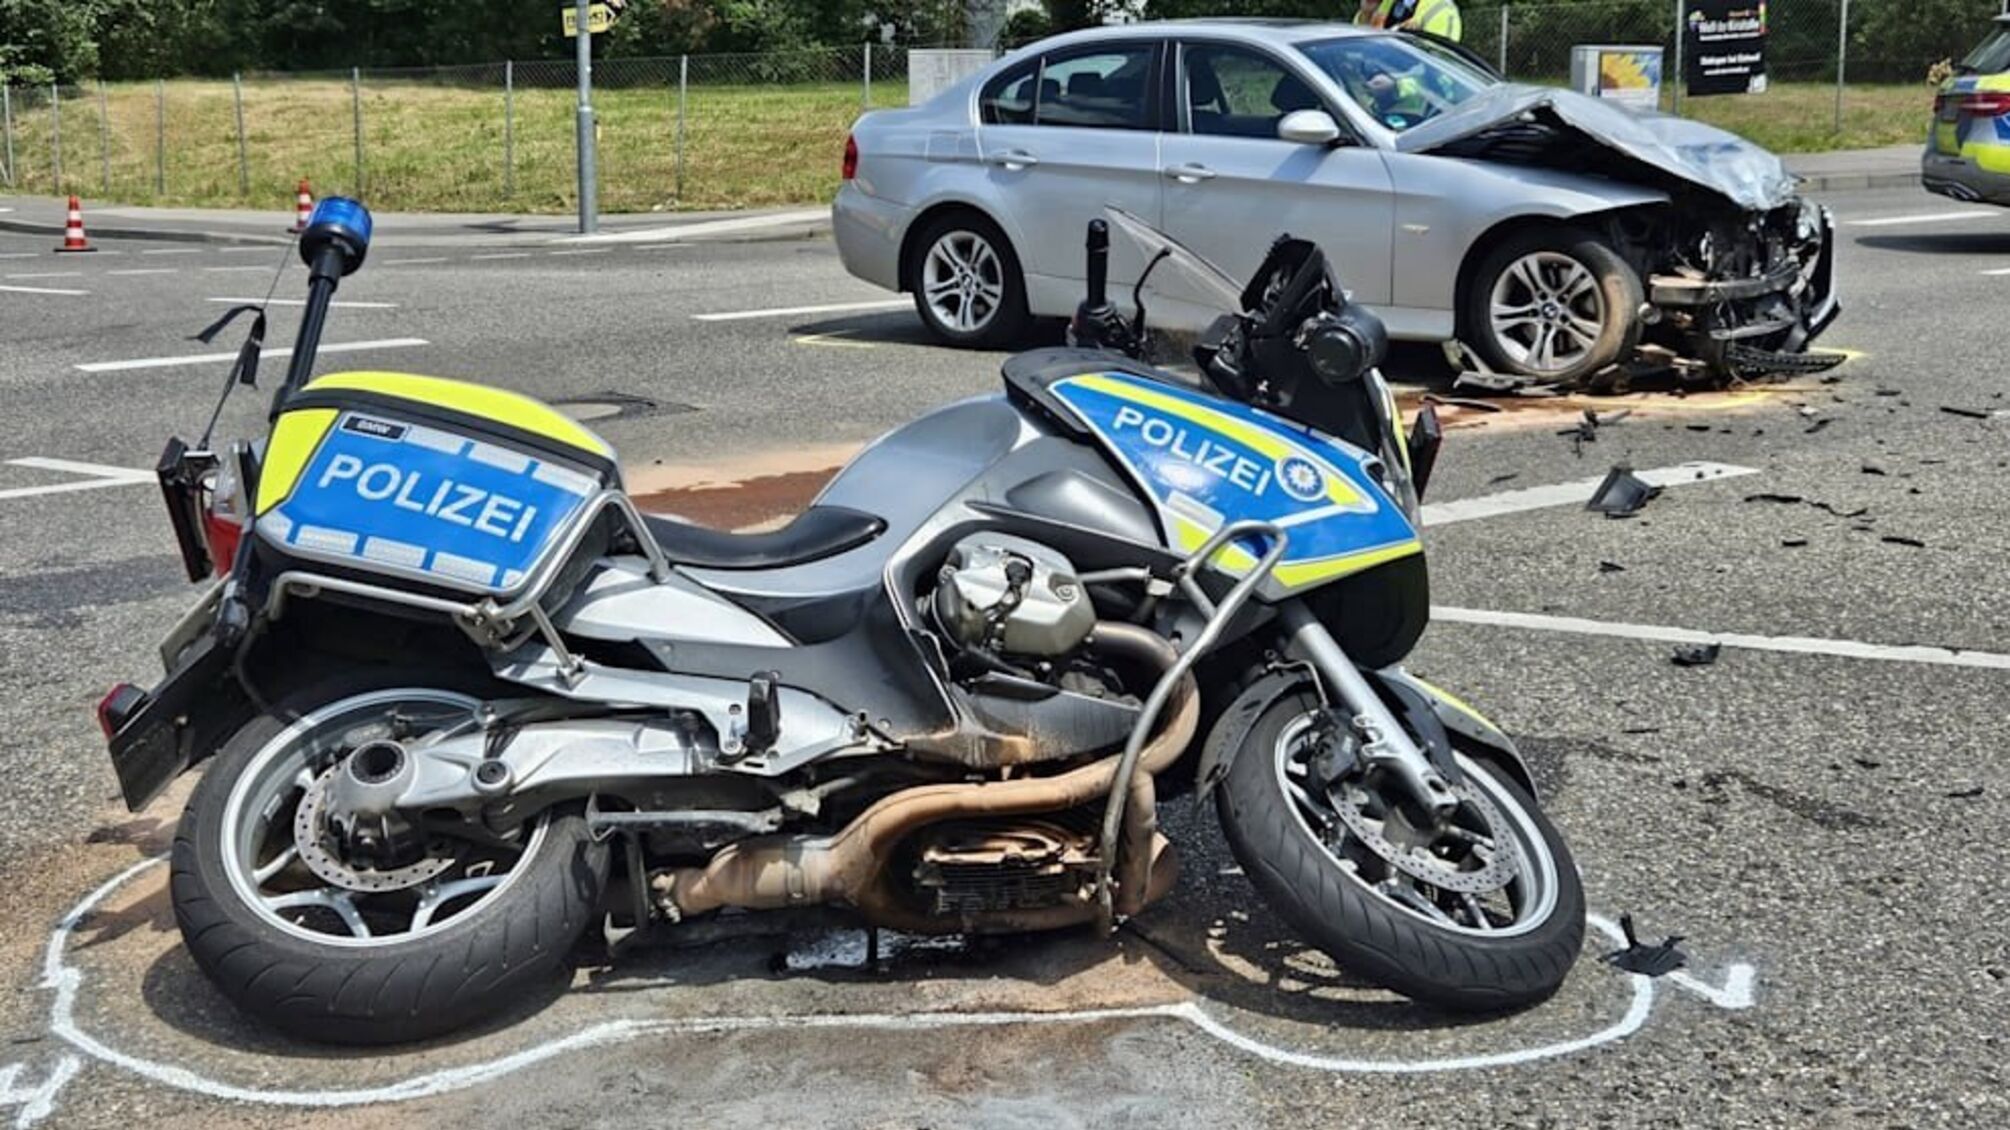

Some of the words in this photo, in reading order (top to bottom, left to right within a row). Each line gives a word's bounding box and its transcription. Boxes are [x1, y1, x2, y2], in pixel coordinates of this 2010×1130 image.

[356, 419, 391, 435] BMW
[1112, 406, 1272, 497] POLIZEI
[317, 453, 537, 543] POLIZEI
